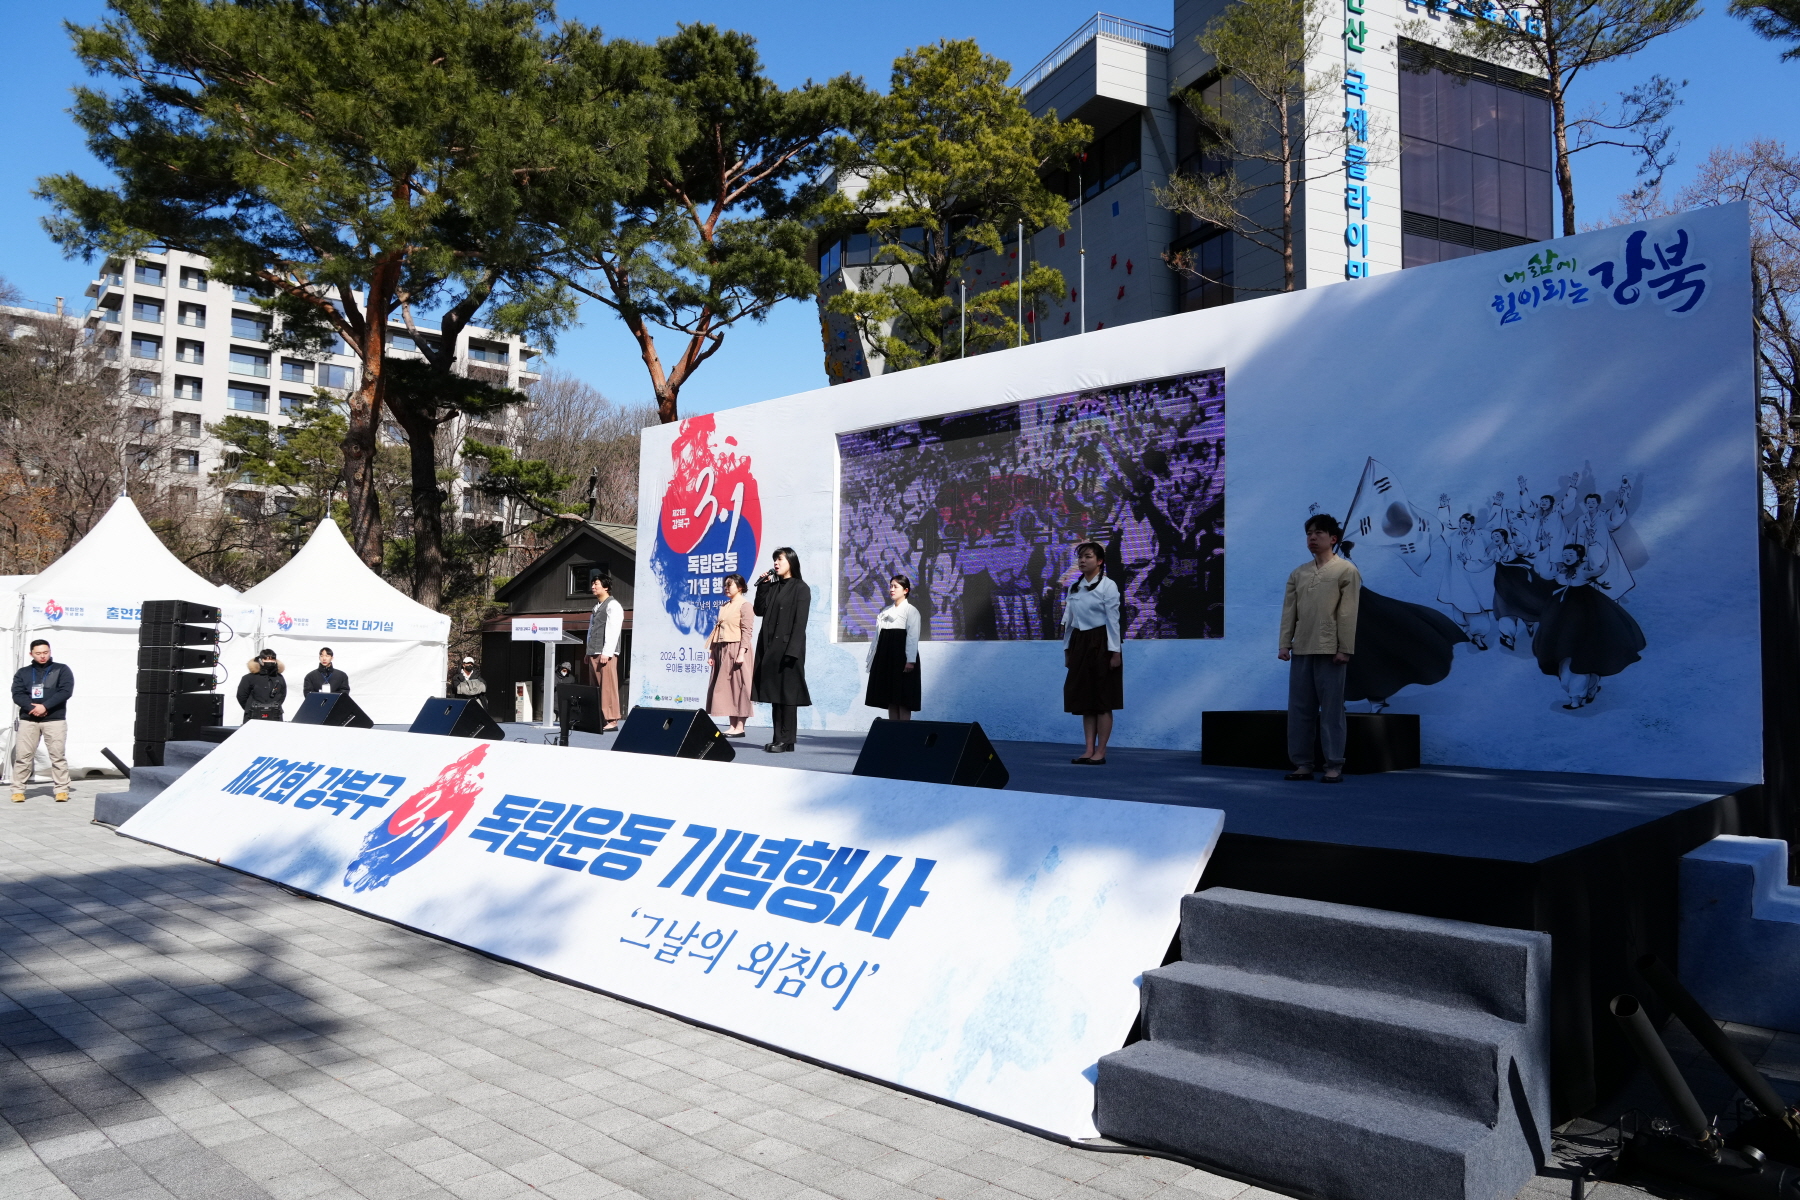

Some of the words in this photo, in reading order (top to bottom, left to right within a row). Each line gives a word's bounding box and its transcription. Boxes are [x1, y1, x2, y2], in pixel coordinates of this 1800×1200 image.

[1588, 228, 1707, 313] 강북
[671, 518, 691, 530] 강북구
[687, 551, 738, 575] 독립운동
[325, 617, 359, 631] 출연진
[361, 619, 394, 632] 대기실
[665, 663, 683, 673] 우이동
[221, 755, 326, 805] 제21회
[293, 766, 407, 820] 강북구
[467, 793, 676, 882] 독립운동
[656, 823, 938, 941] 기념행사
